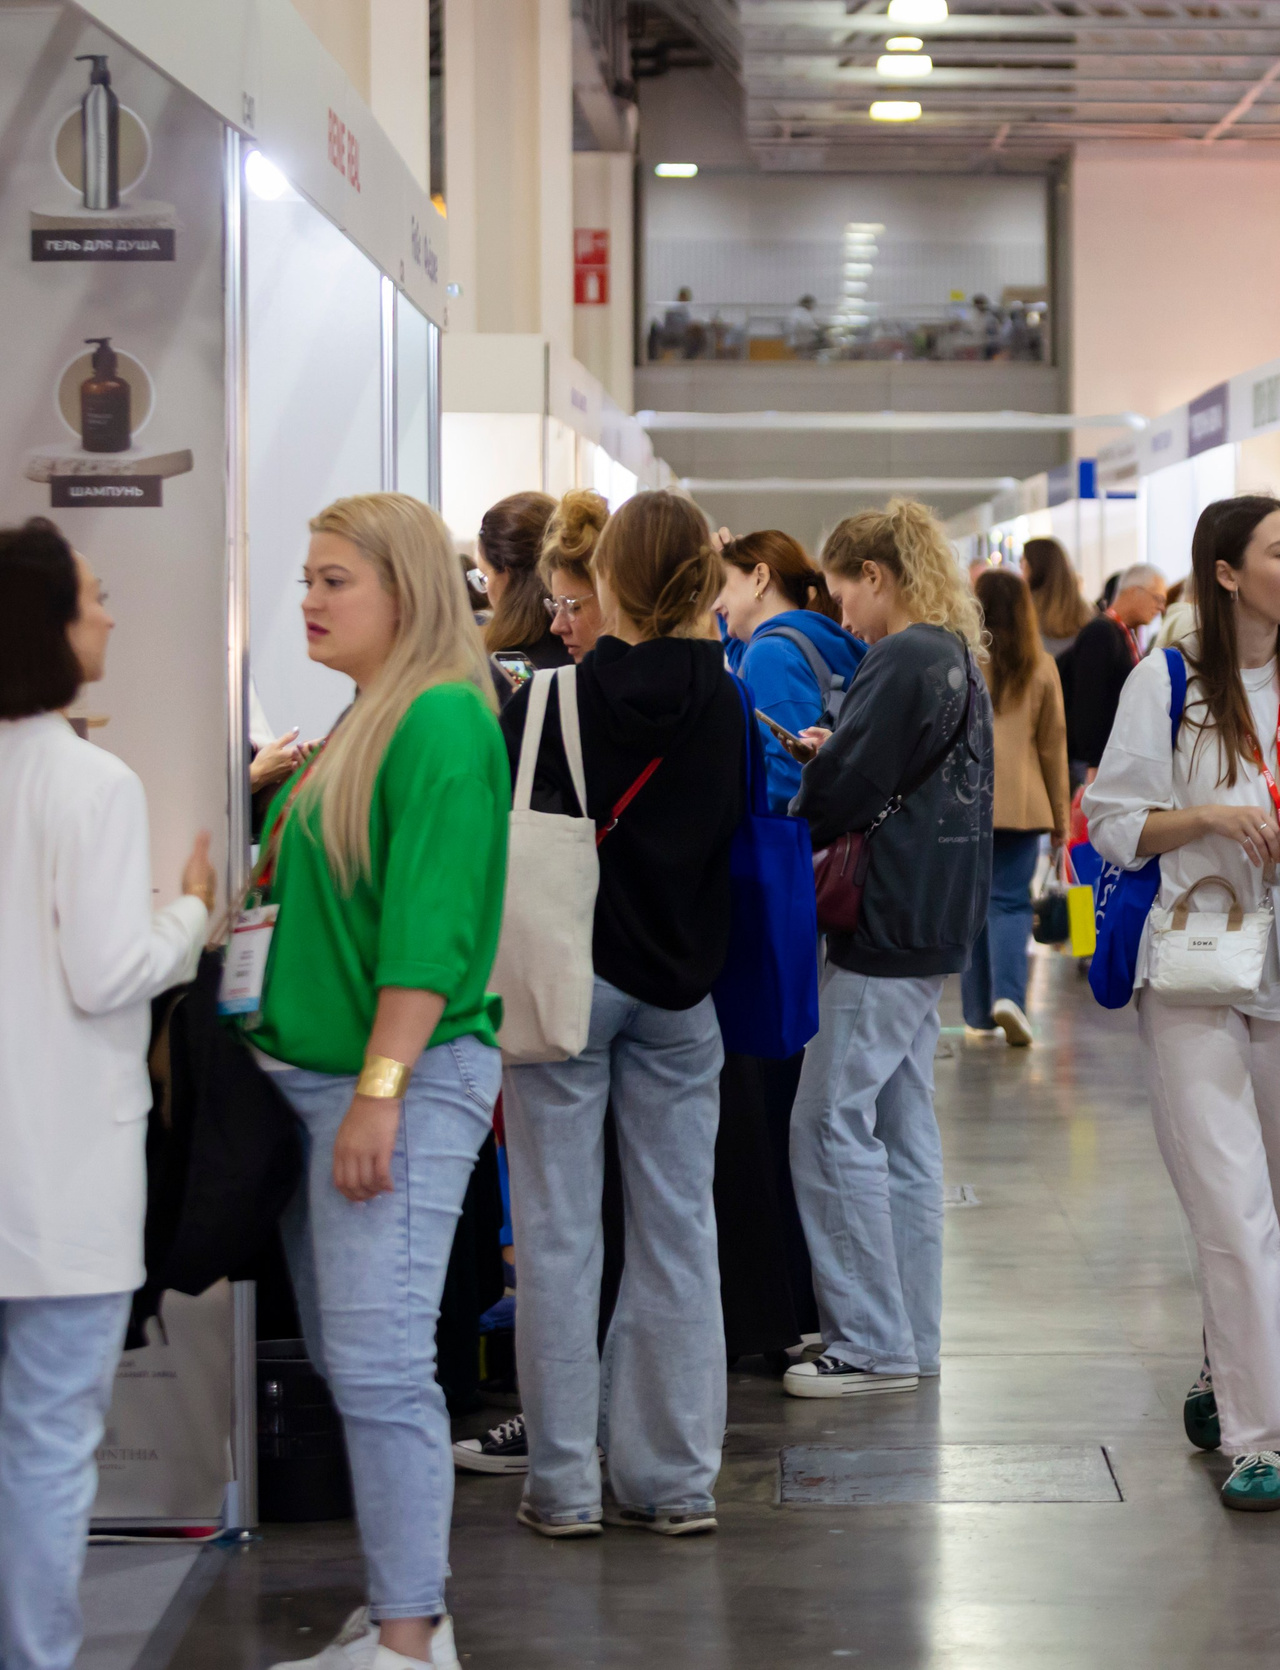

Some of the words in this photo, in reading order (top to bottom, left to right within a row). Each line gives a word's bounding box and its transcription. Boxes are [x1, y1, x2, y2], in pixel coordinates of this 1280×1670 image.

[46, 240, 81, 251] ГЕЛЬ
[83, 240, 113, 252] ДЛЯ
[116, 240, 161, 252] ДУША
[69, 486, 144, 498] ШАМПУНЬ
